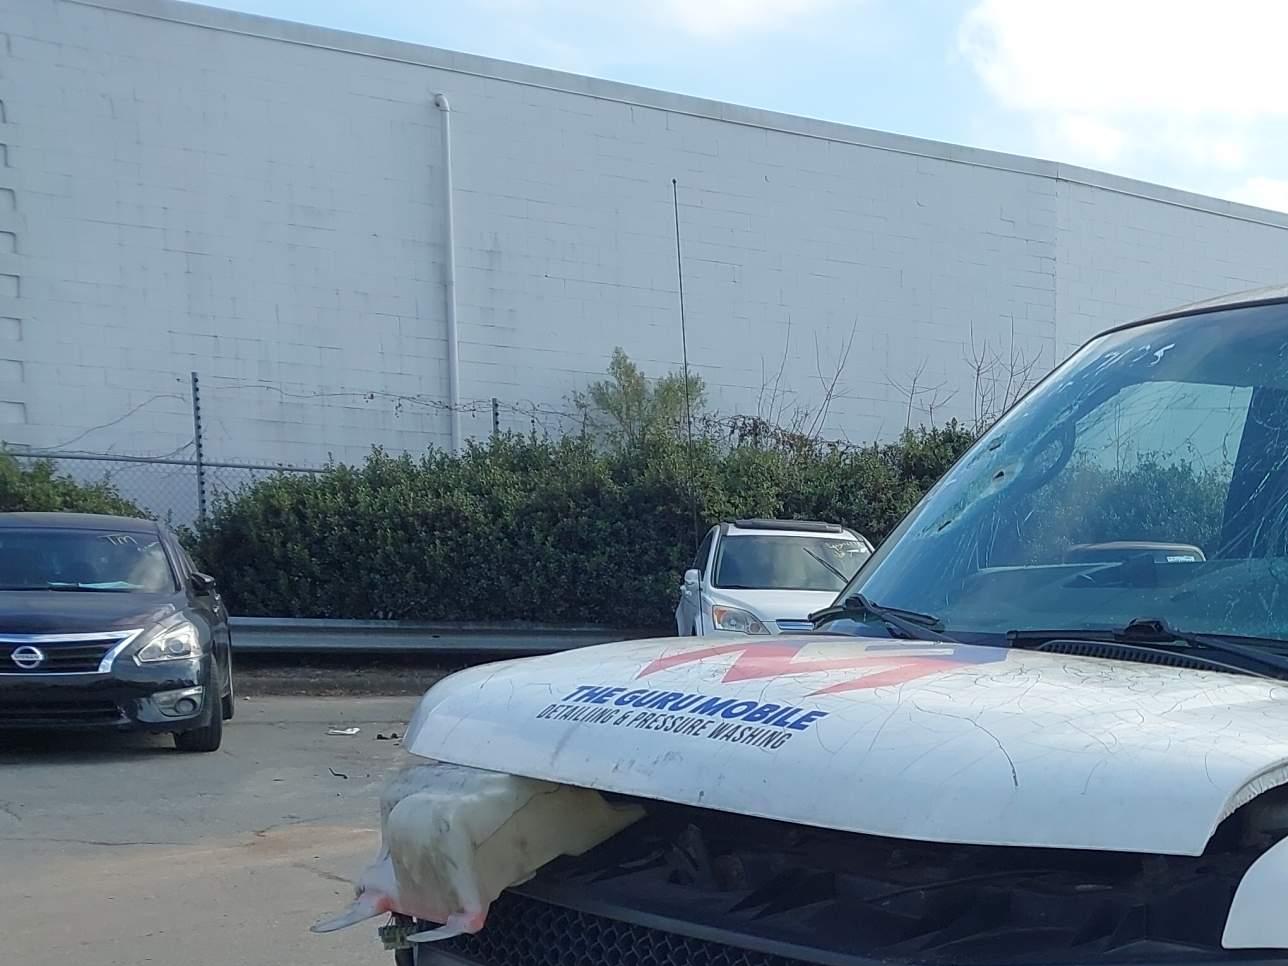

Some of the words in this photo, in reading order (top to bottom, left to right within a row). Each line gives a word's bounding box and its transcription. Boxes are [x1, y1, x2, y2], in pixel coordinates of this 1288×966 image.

[561, 685, 629, 705] THE
[614, 689, 706, 712] GURU
[690, 697, 829, 731] MOBILE
[613, 710, 634, 727] &
[626, 712, 715, 737] PRESSURE
[707, 721, 793, 750] WASHING
